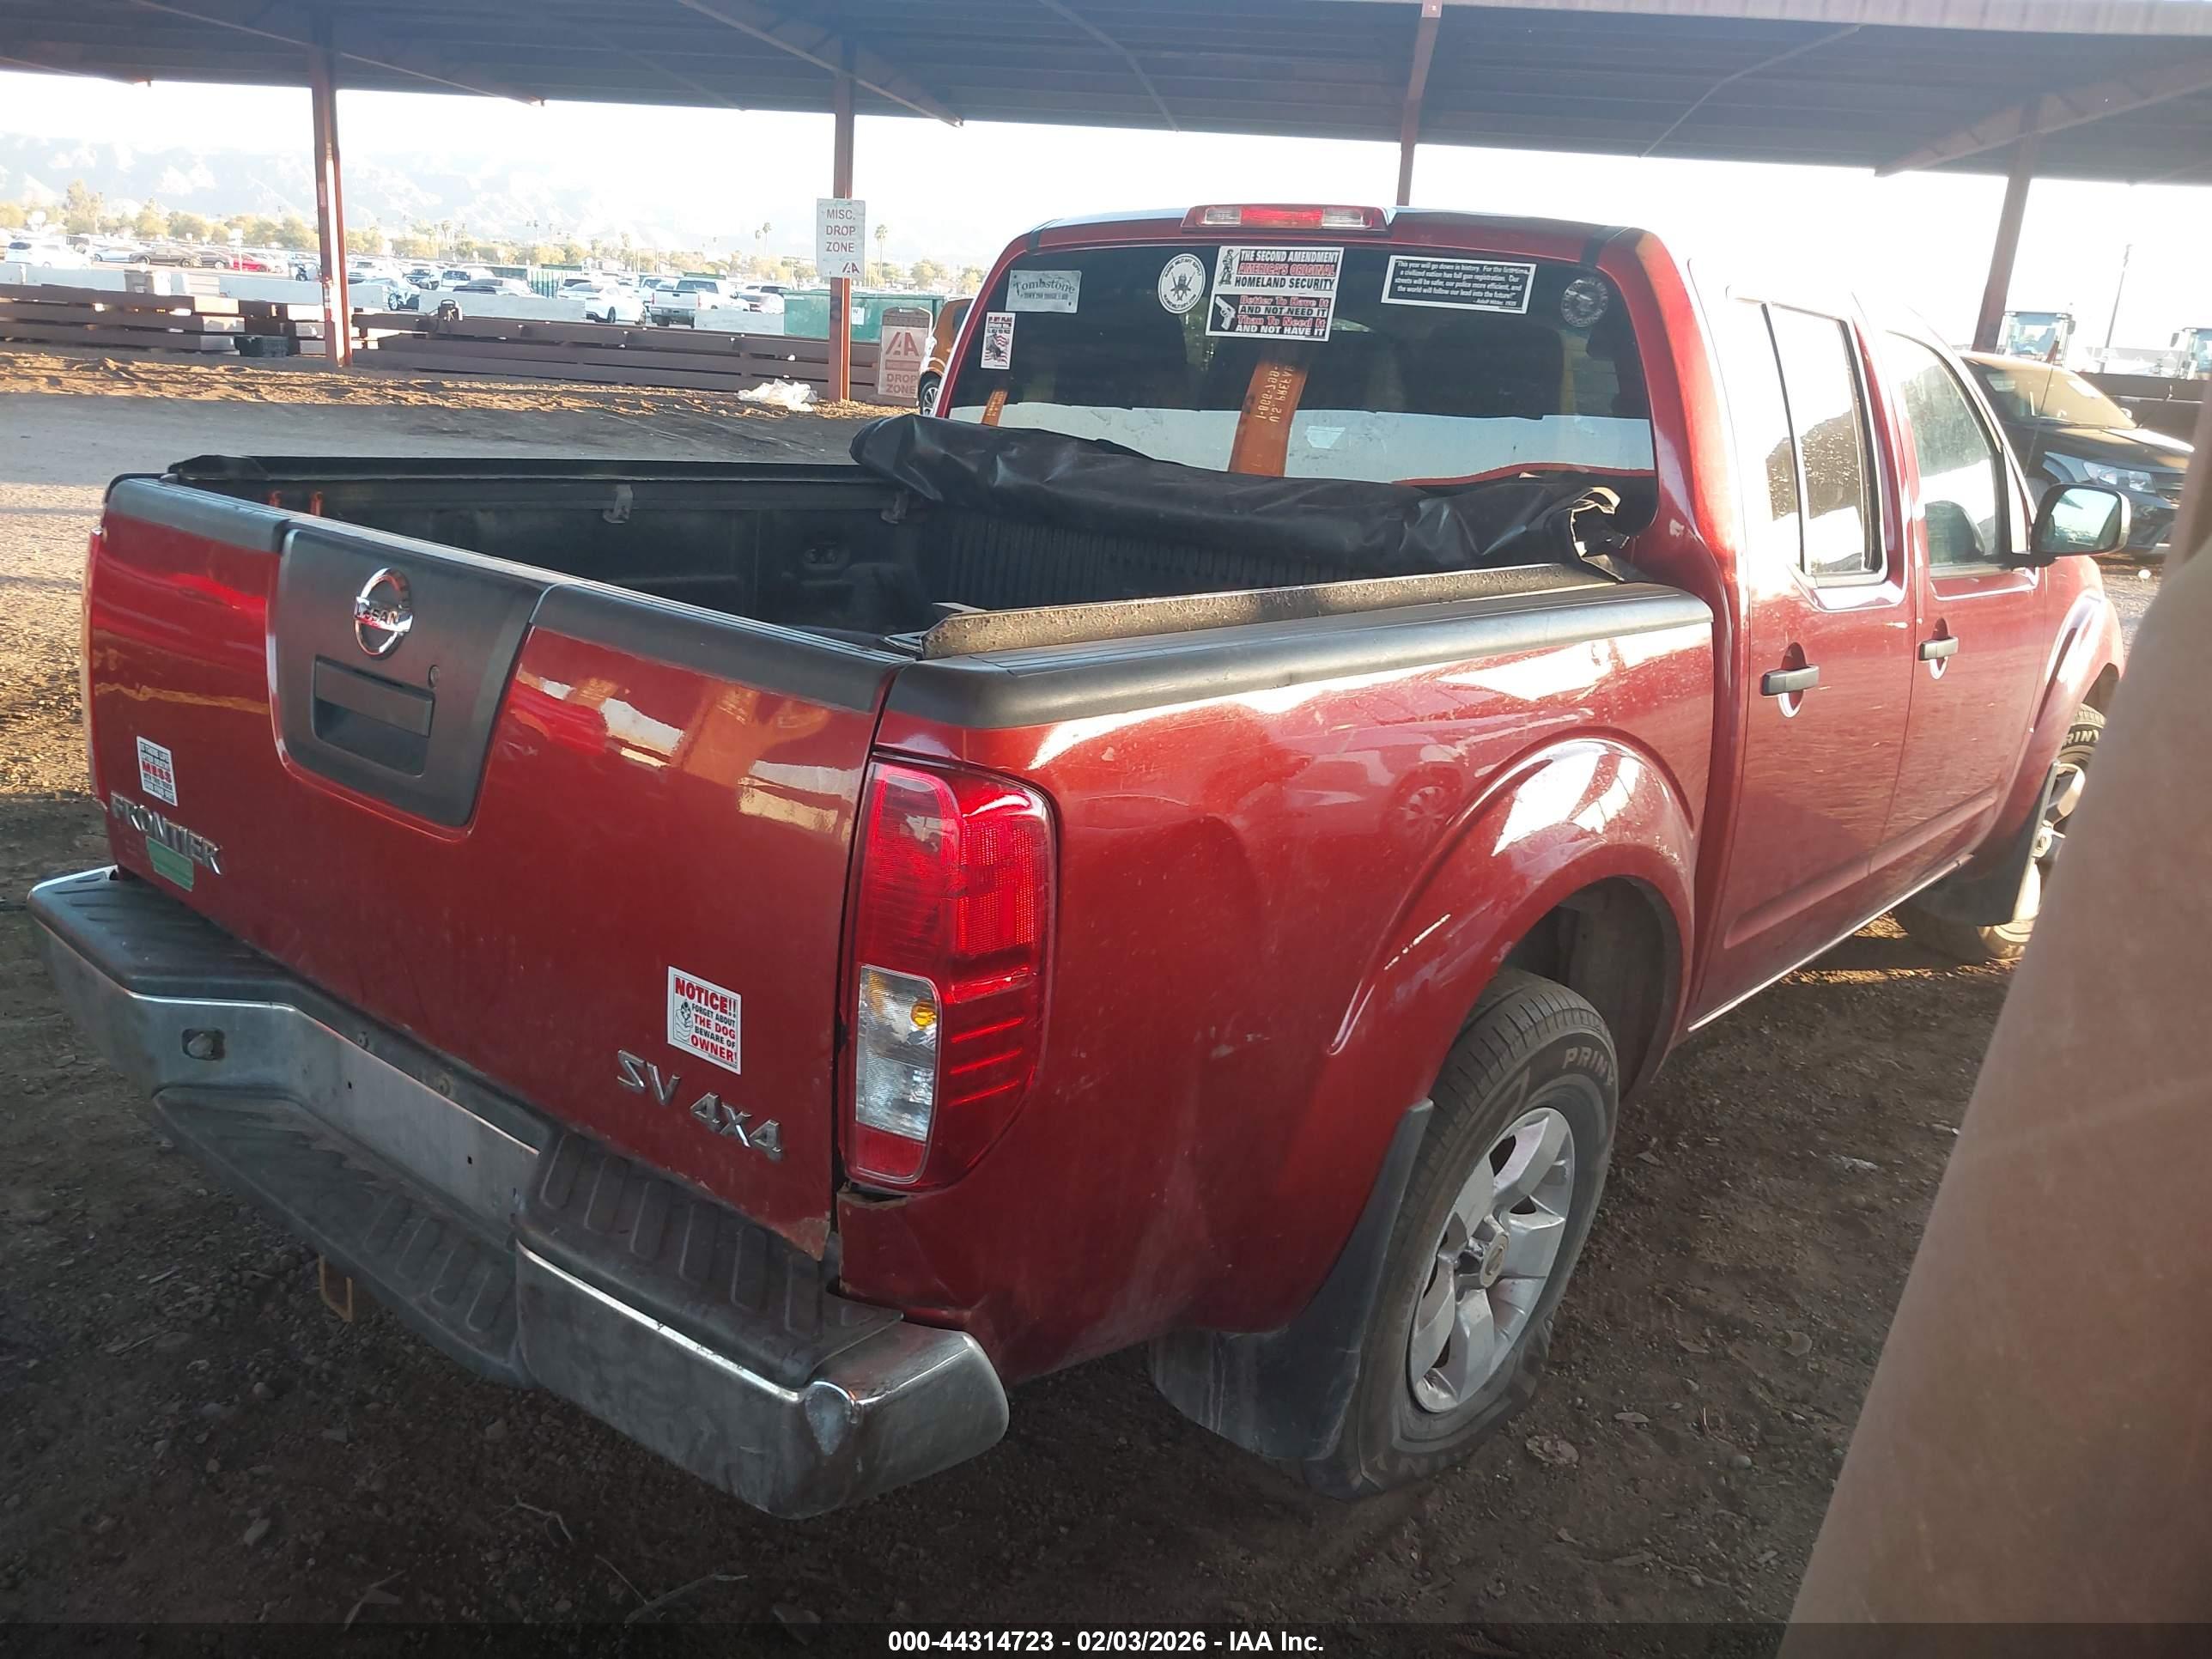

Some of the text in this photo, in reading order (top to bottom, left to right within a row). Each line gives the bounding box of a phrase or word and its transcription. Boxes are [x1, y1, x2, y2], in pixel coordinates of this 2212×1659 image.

[826, 209, 856, 221] MISC.
[826, 225, 856, 236] DROP
[825, 241, 854, 252] ZONE
[1240, 250, 1340, 263] THE SECOND AMENDMENT
[1237, 262, 1336, 276] AMERICA'S ORIGINAL
[1013, 277, 1076, 296] Tombstone
[1234, 276, 1335, 290] HOMELAND SECURITY
[1239, 295, 1329, 307] Better To Have It
[1286, 307, 1314, 316] NEED
[1316, 308, 1327, 317] IT
[1237, 315, 1326, 327] Than To Need It
[1235, 325, 1325, 337] AND NOT HAVE IT
[886, 373, 918, 383] DROP
[885, 384, 916, 394] ZONE
[110, 790, 222, 875] FRONTIER
[675, 976, 737, 1018] NOTICE!!
[691, 1003, 736, 1028] FORGET ABOUT
[694, 1013, 736, 1040] THE DOG
[695, 1026, 736, 1048] BEWARE OF
[690, 1034, 738, 1064] OWNER!
[617, 1049, 681, 1106] SV
